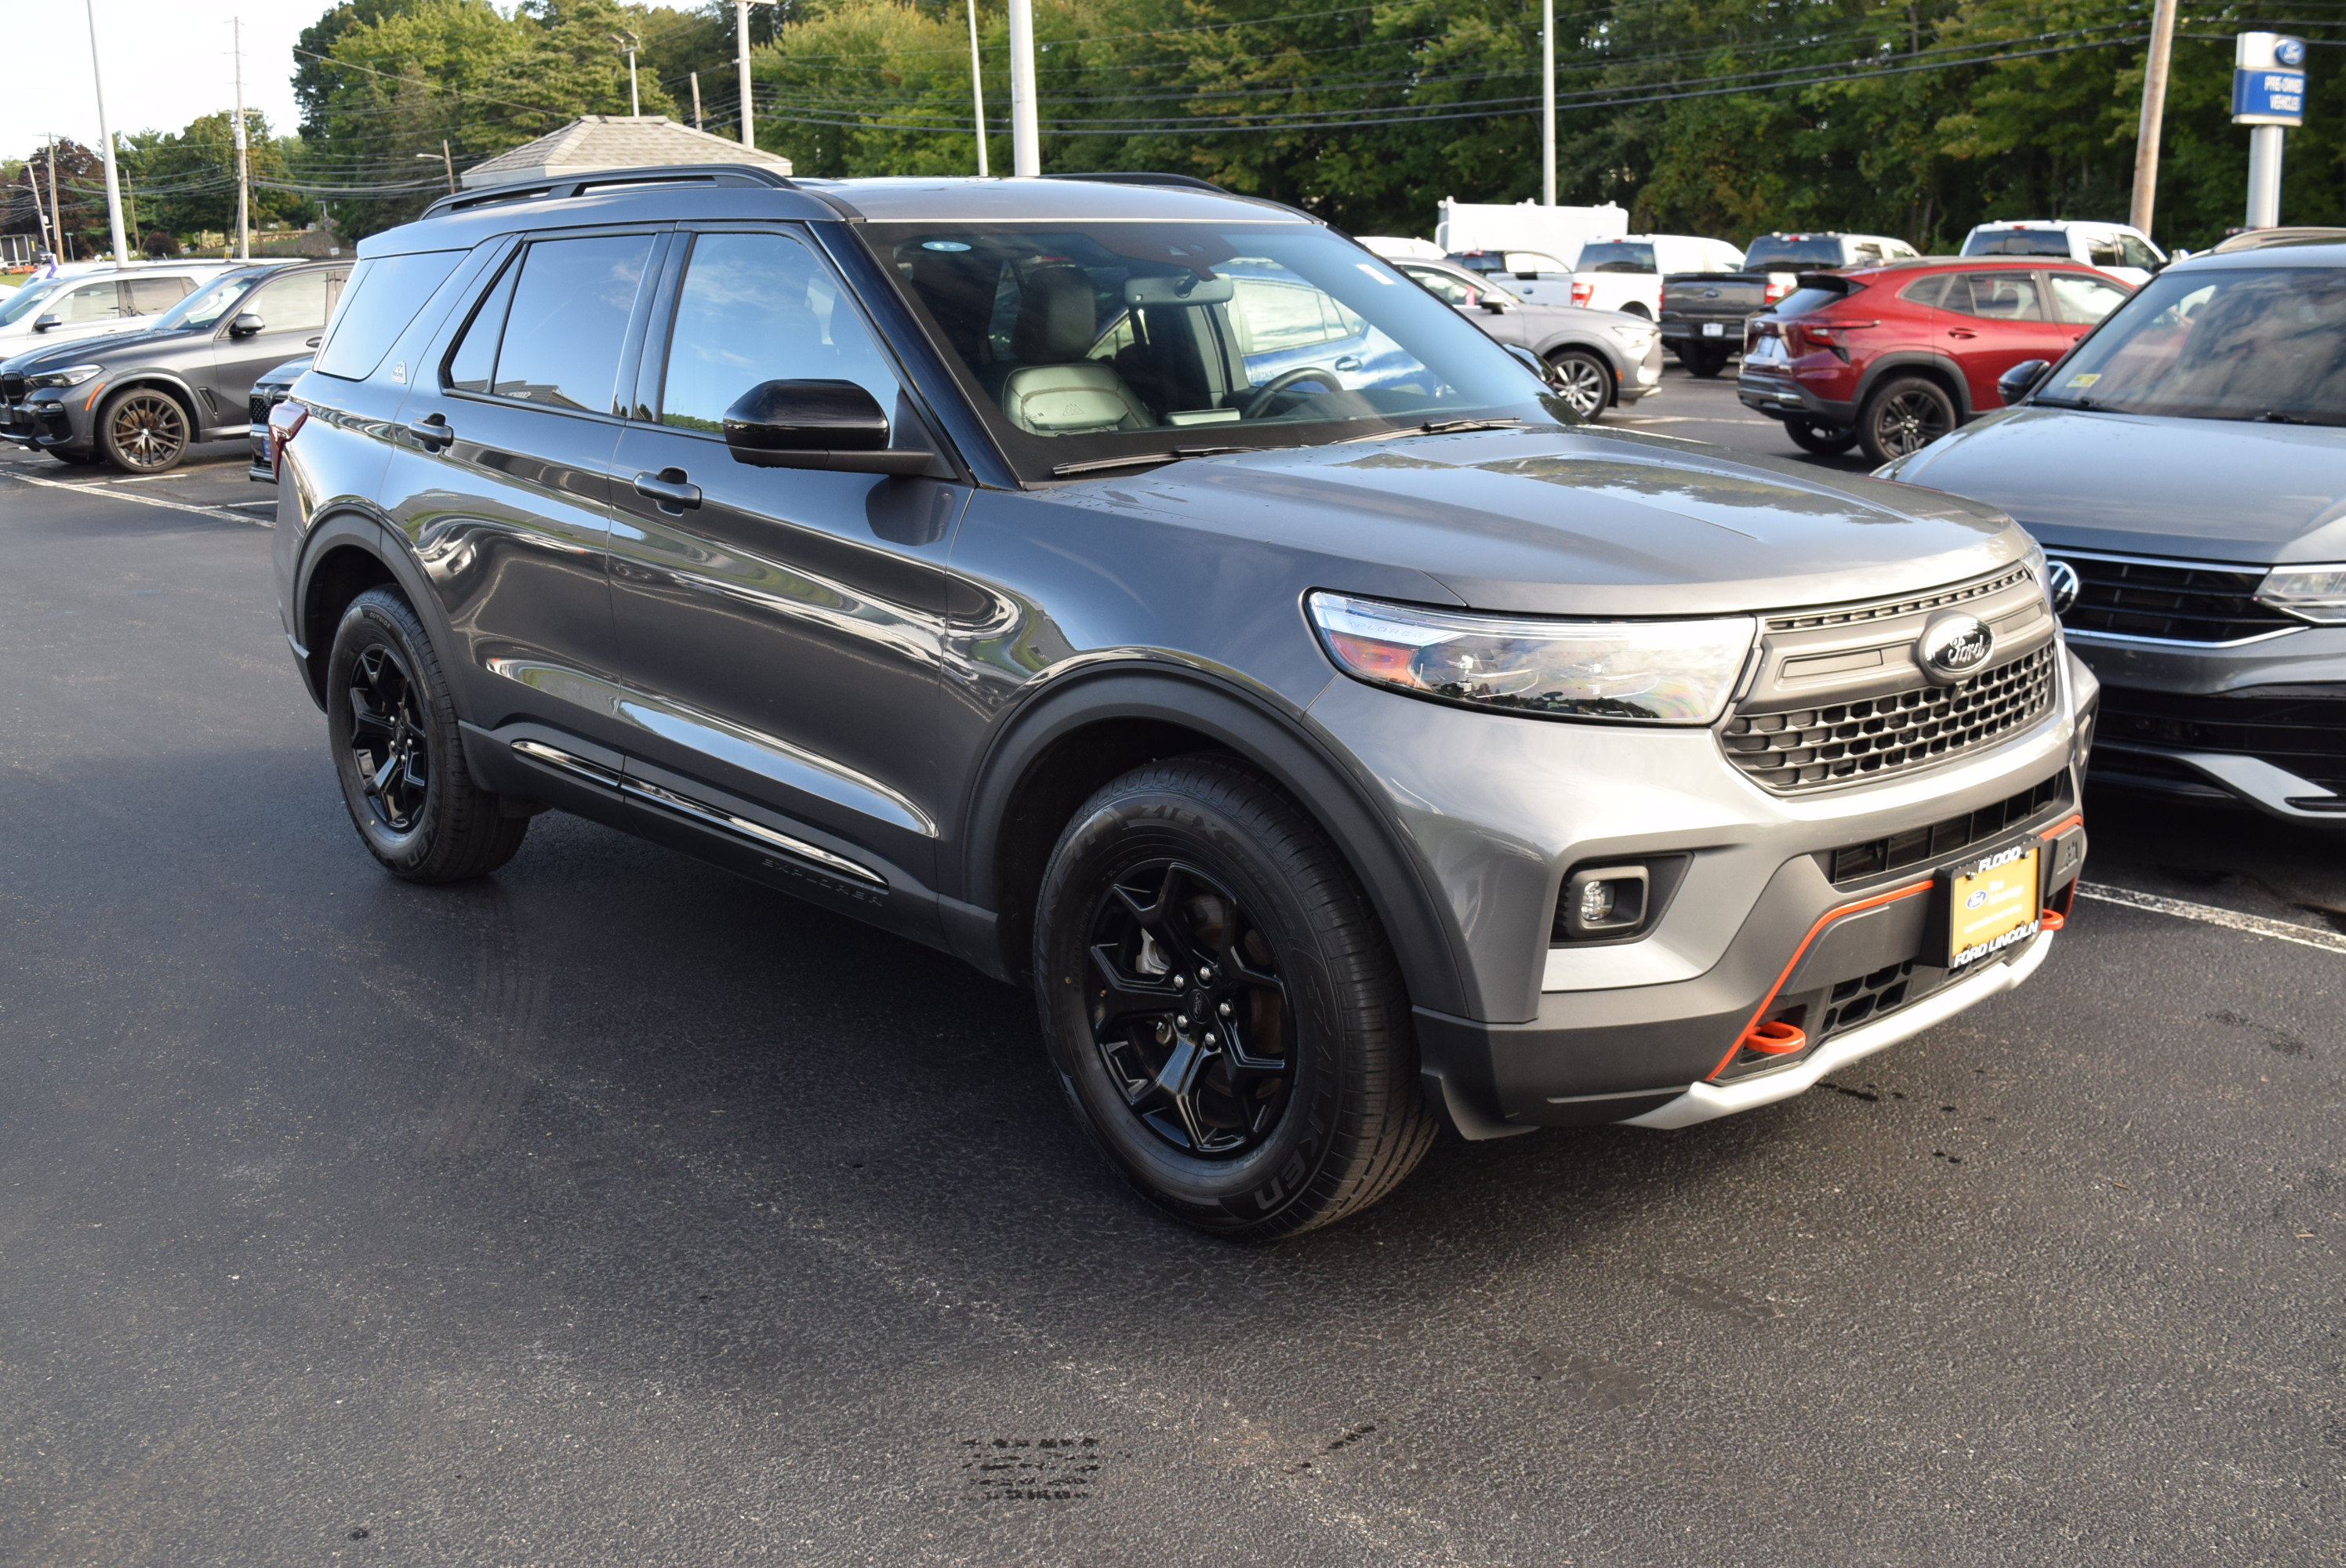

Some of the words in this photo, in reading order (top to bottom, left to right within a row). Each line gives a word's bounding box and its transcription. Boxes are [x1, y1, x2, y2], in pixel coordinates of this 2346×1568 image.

[1948, 630, 1985, 666] Ford
[1978, 846, 2021, 873] FLOOD
[761, 858, 884, 908] EXPLORER
[1953, 944, 1988, 968] FORD
[1988, 919, 2039, 953] LINCOLN
